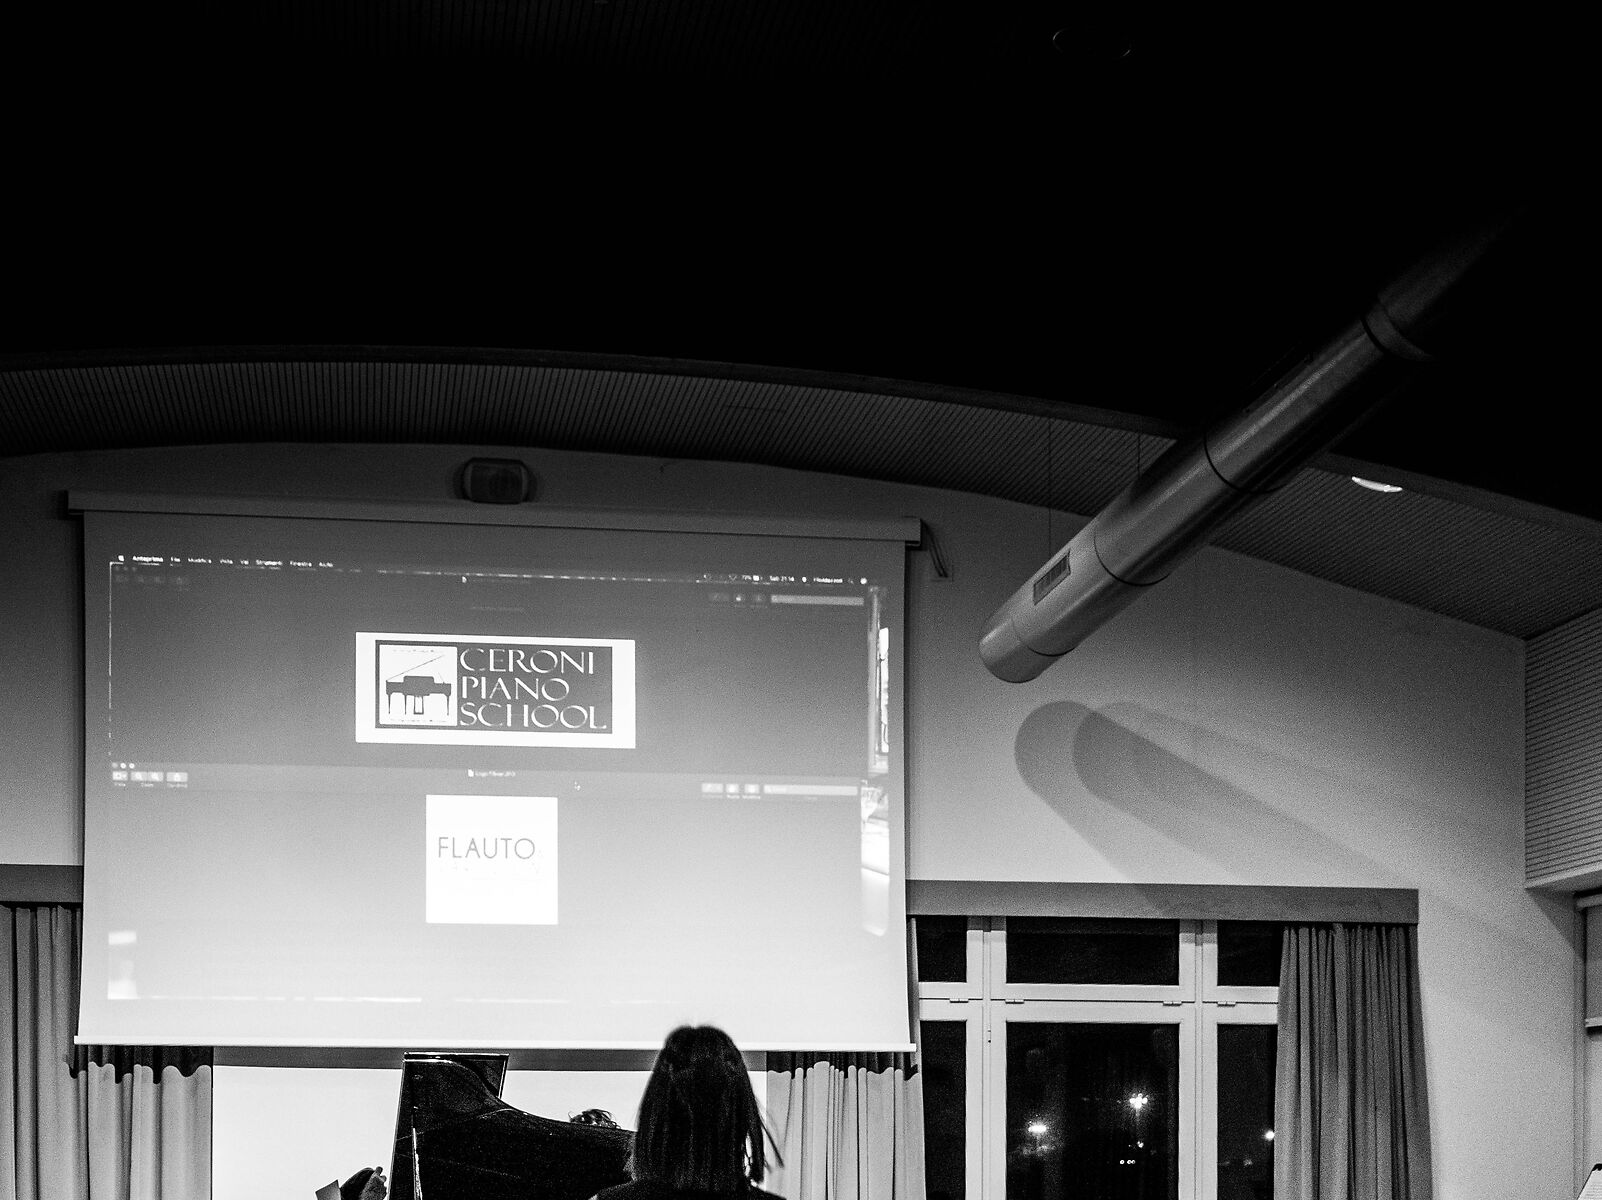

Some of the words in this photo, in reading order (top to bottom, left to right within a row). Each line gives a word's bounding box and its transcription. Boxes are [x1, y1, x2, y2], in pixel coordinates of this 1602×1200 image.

[459, 648, 594, 675] CERONI
[461, 676, 570, 702] PIANO
[459, 702, 607, 730] SCHOOL
[438, 836, 536, 860] FLAUTO
